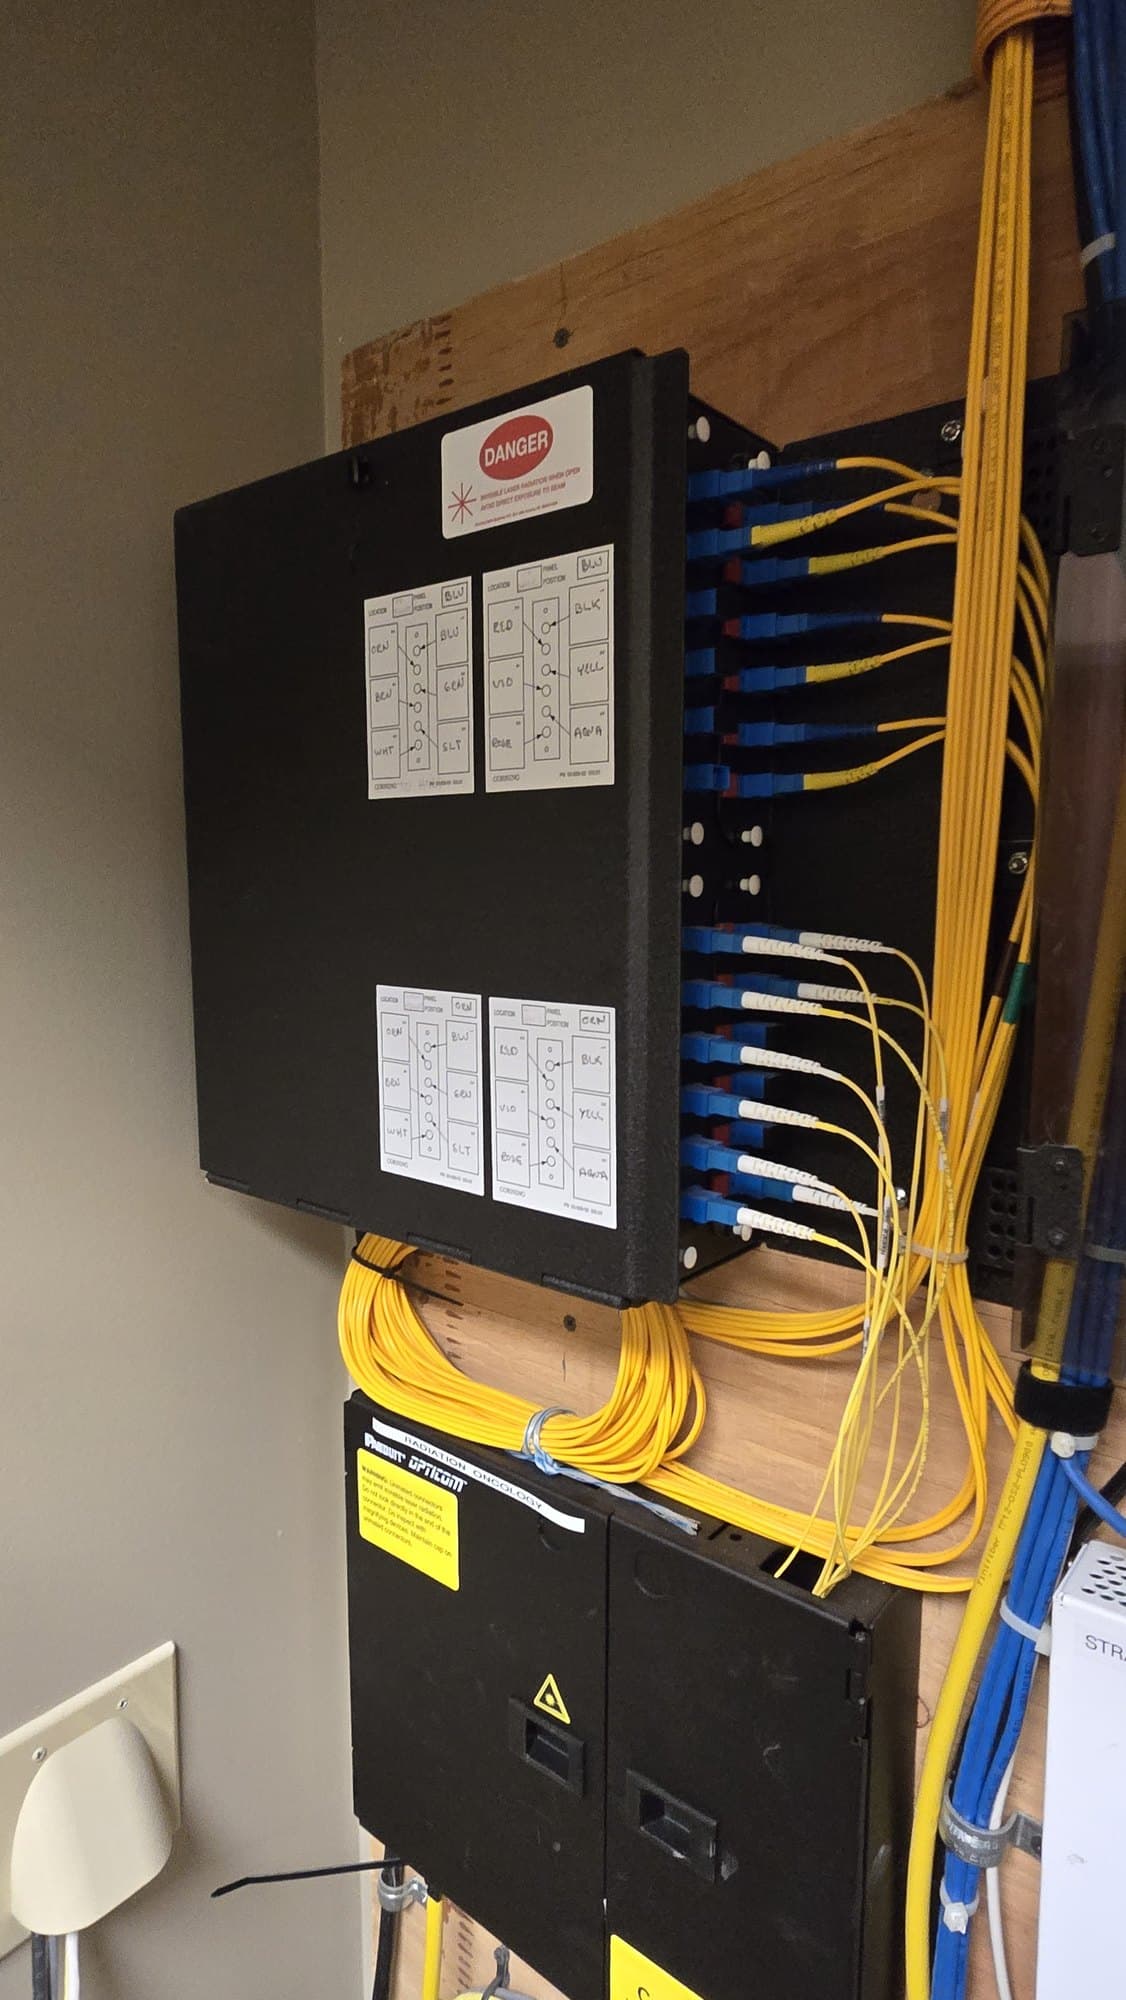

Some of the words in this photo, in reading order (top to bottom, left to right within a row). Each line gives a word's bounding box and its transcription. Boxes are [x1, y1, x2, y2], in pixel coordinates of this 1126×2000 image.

[484, 430, 548, 467] DANGER
[504, 485, 520, 496] LASER
[521, 478, 547, 489] RADIATION
[549, 472, 564, 482] WHEN
[565, 467, 580, 477] OPEN
[515, 489, 542, 504] EXPOSURE
[543, 487, 549, 495] TO
[551, 482, 566, 493] BEAM
[581, 557, 602, 573] BLU
[445, 587, 464, 601] BLU
[575, 599, 601, 614] BLK
[441, 627, 459, 640] BLU
[374, 746, 394, 755] WHT
[442, 740, 461, 752] SLT
[404, 1436, 466, 1471] RADIATION
[472, 1469, 543, 1510] ONCOLOGY
[408, 1456, 465, 1493] OPTICOM
[1085, 1634, 1126, 1661] STR
